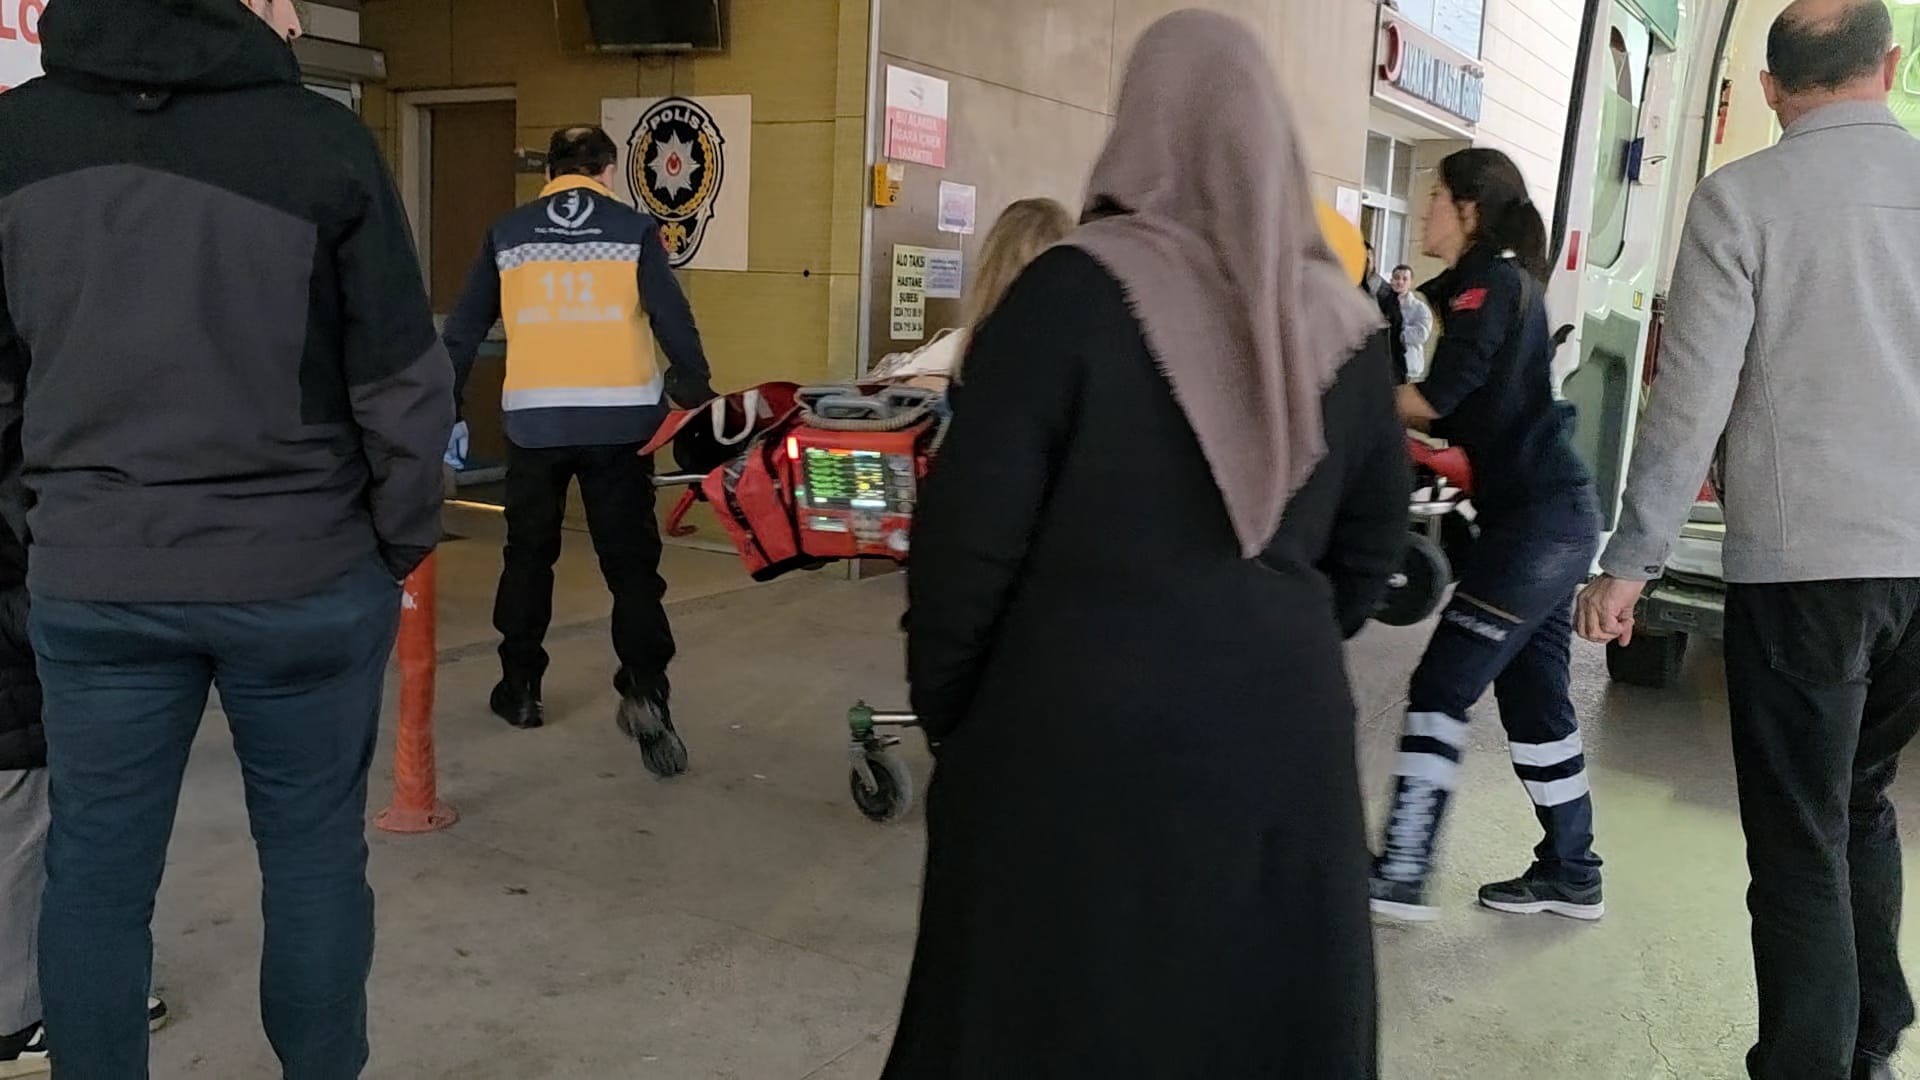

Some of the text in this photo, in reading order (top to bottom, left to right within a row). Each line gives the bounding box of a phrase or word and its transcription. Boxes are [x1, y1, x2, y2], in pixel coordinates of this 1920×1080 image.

[650, 108, 701, 129] POLİS
[896, 253, 908, 267] ALO
[541, 271, 595, 303] 112
[897, 276, 922, 288] HASTANE
